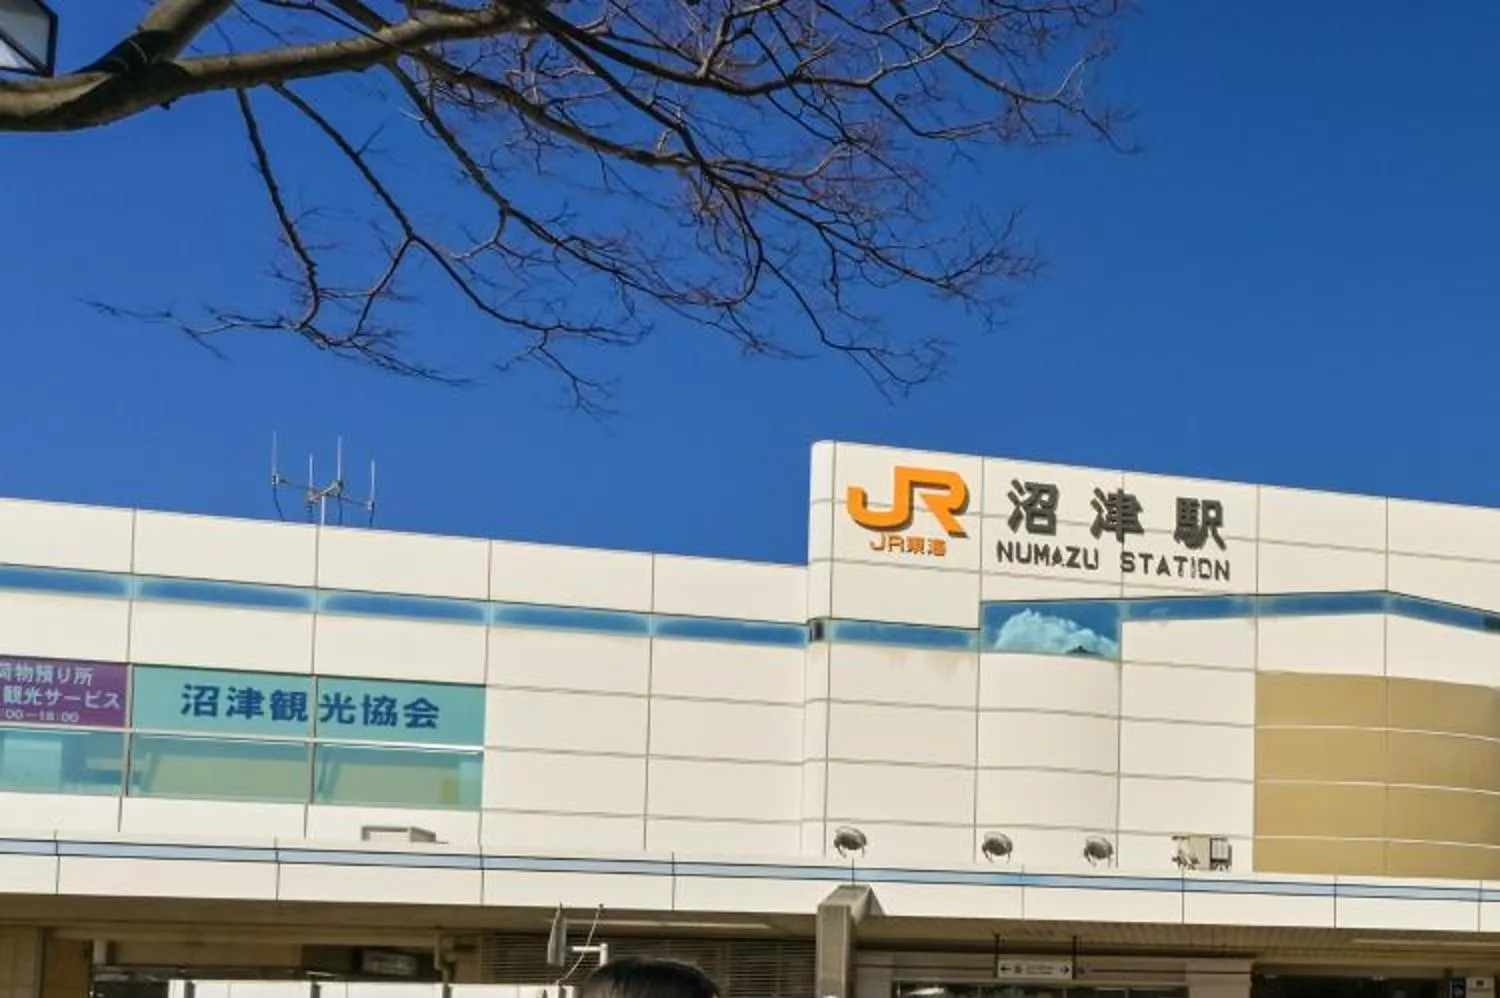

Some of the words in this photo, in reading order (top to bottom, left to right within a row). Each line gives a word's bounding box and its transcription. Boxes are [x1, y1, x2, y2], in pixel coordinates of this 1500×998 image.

[847, 466, 968, 538] JR
[1007, 479, 1227, 550] 沼津駅
[996, 540, 1099, 570] NUMAZU
[1120, 551, 1231, 581] STATION
[181, 683, 440, 728] 沼津観光協会
